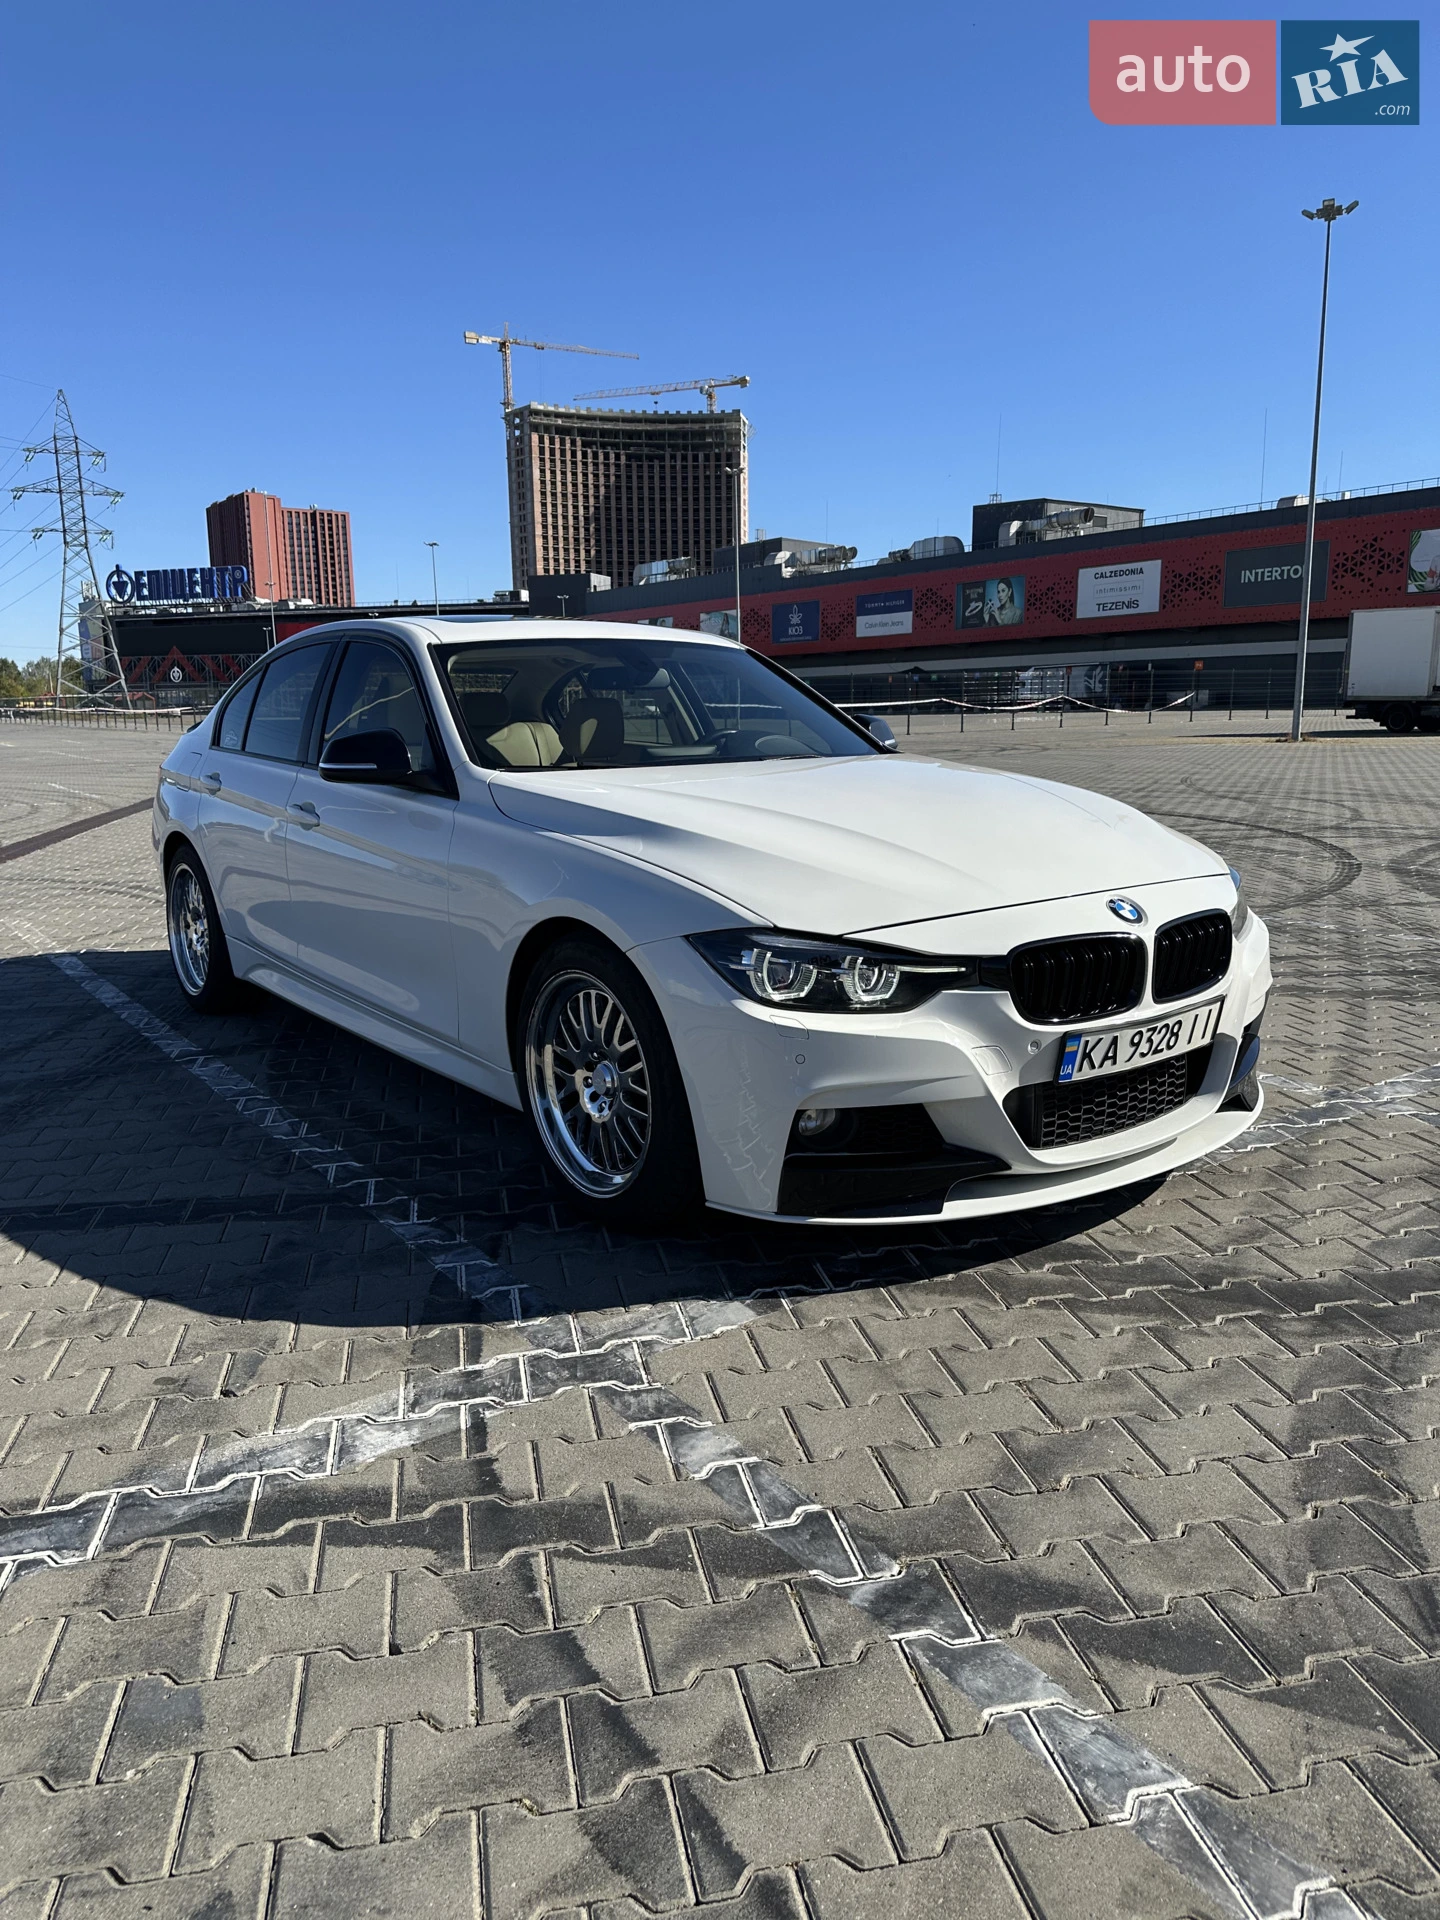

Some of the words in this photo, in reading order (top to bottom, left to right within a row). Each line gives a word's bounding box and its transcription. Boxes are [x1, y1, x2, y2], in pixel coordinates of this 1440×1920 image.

[1094, 567, 1144, 580] CALZEDONIA
[1240, 564, 1306, 584] INTERTO
[1096, 584, 1141, 594] intimissimi
[1060, 1065, 1072, 1075] UA
[1124, 1019, 1183, 1063] 9328
